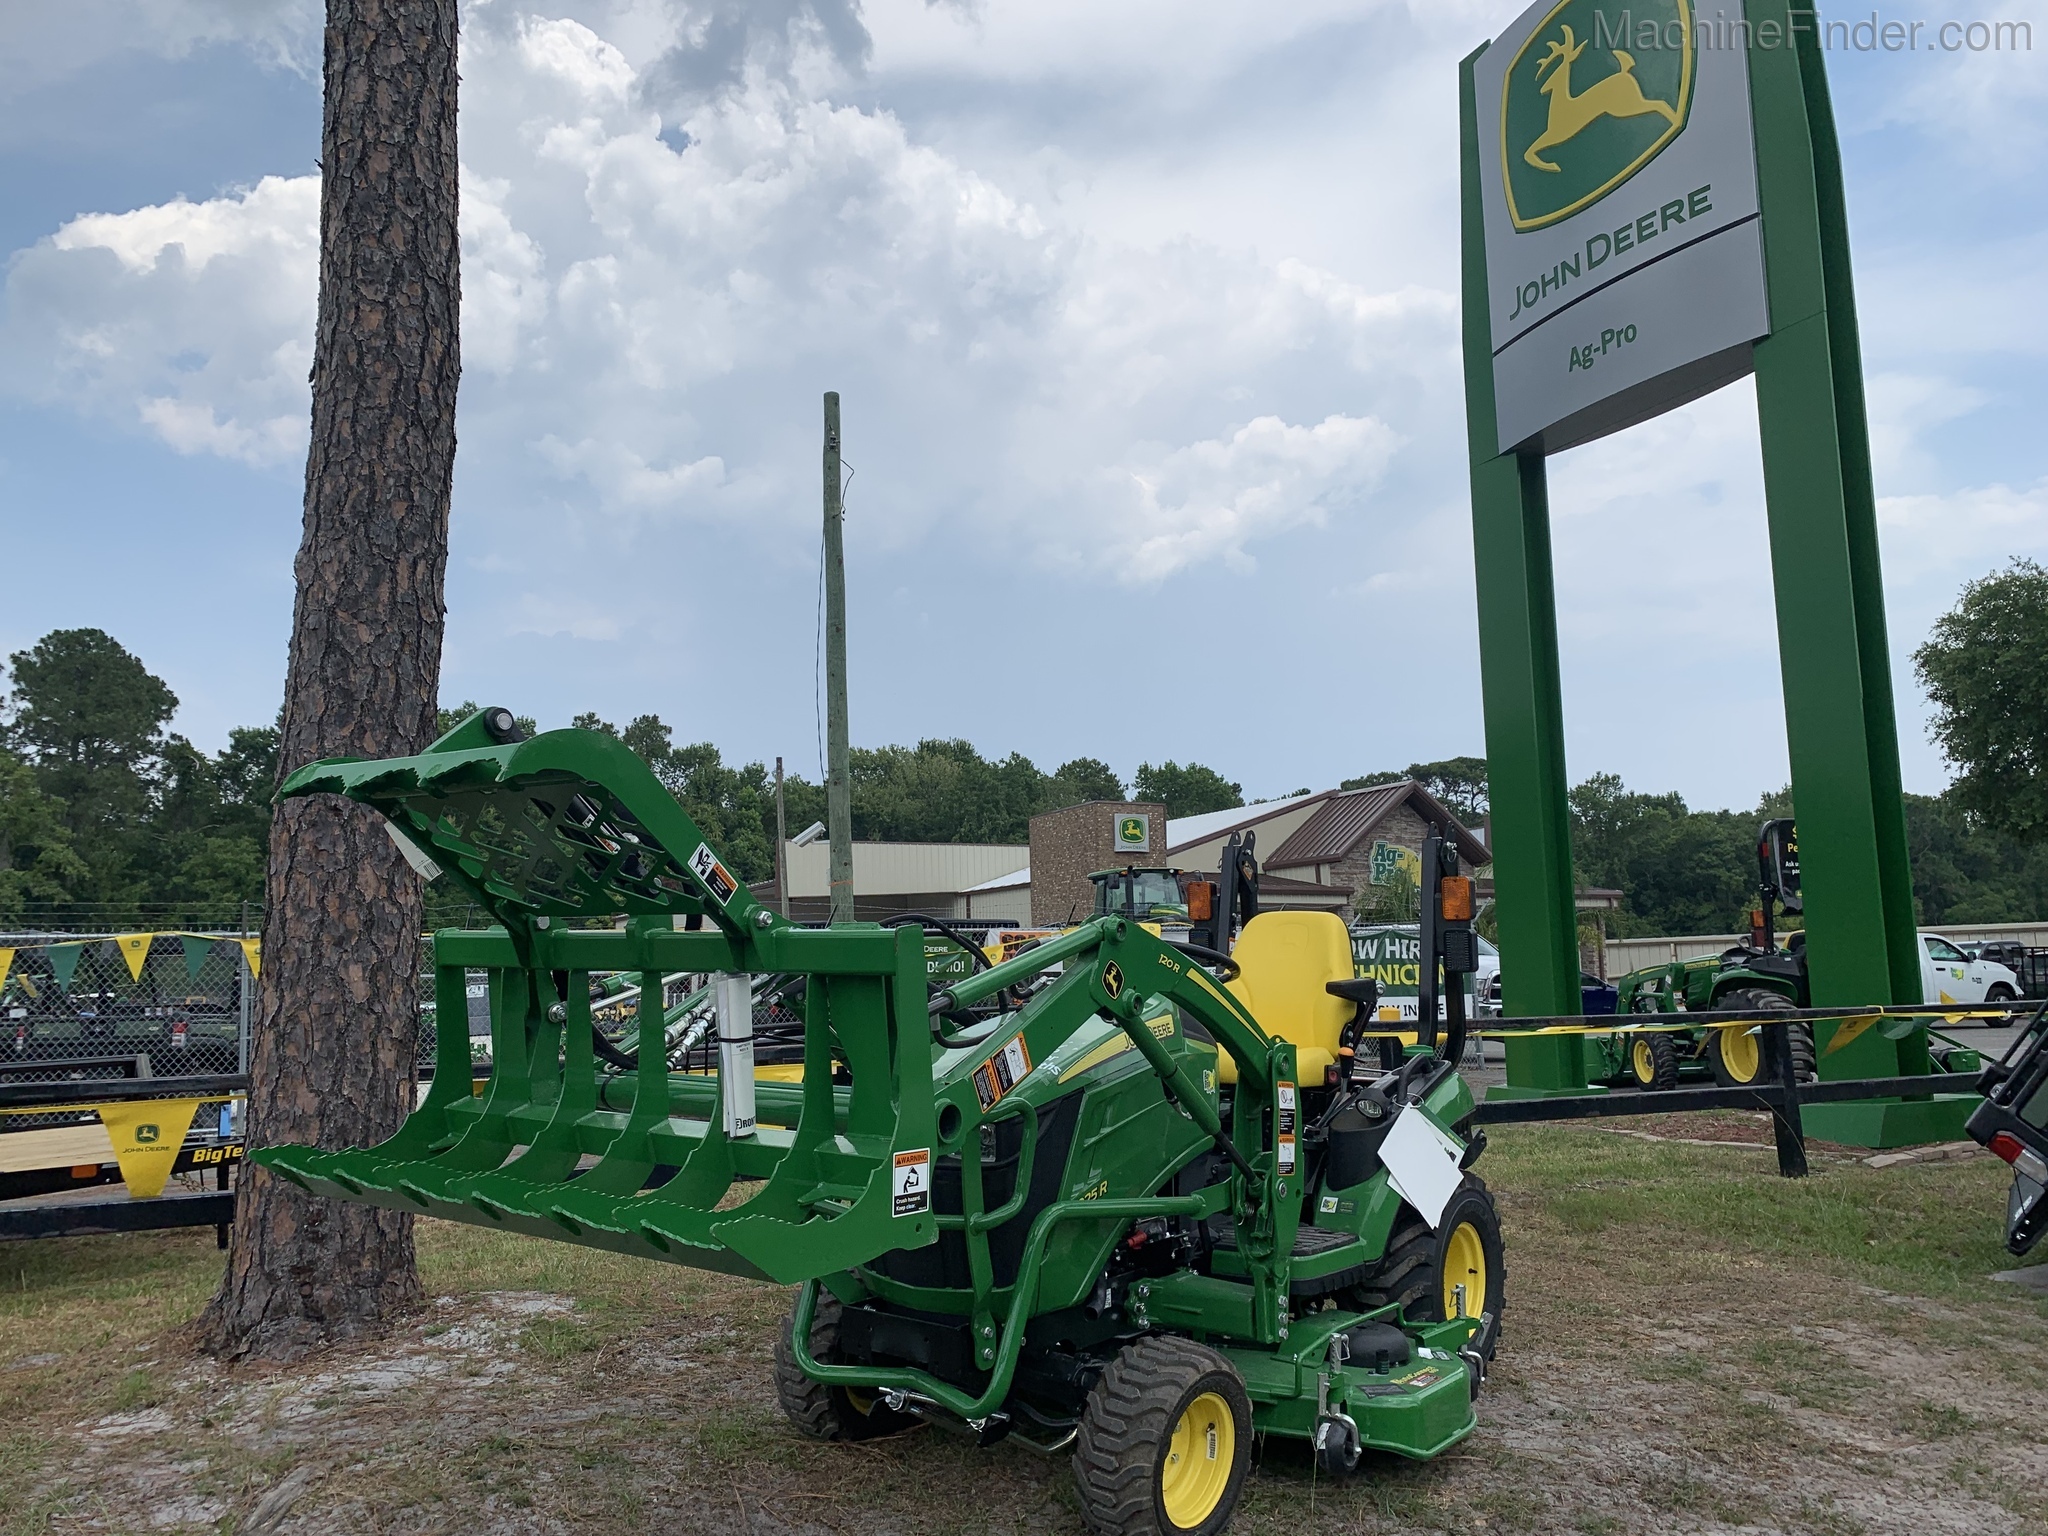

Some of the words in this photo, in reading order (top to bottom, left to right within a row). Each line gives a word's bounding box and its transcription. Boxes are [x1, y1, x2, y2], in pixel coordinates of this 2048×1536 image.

[1510, 252, 1581, 321] JOHN
[1586, 184, 1713, 271] DEERE
[1568, 323, 1637, 372] Ag-Pro
[1787, 842, 1799, 853] Pe
[924, 945, 949, 953] DEERE
[192, 1145, 243, 1164] BigTe
[901, 1153, 927, 1164] WARNING
